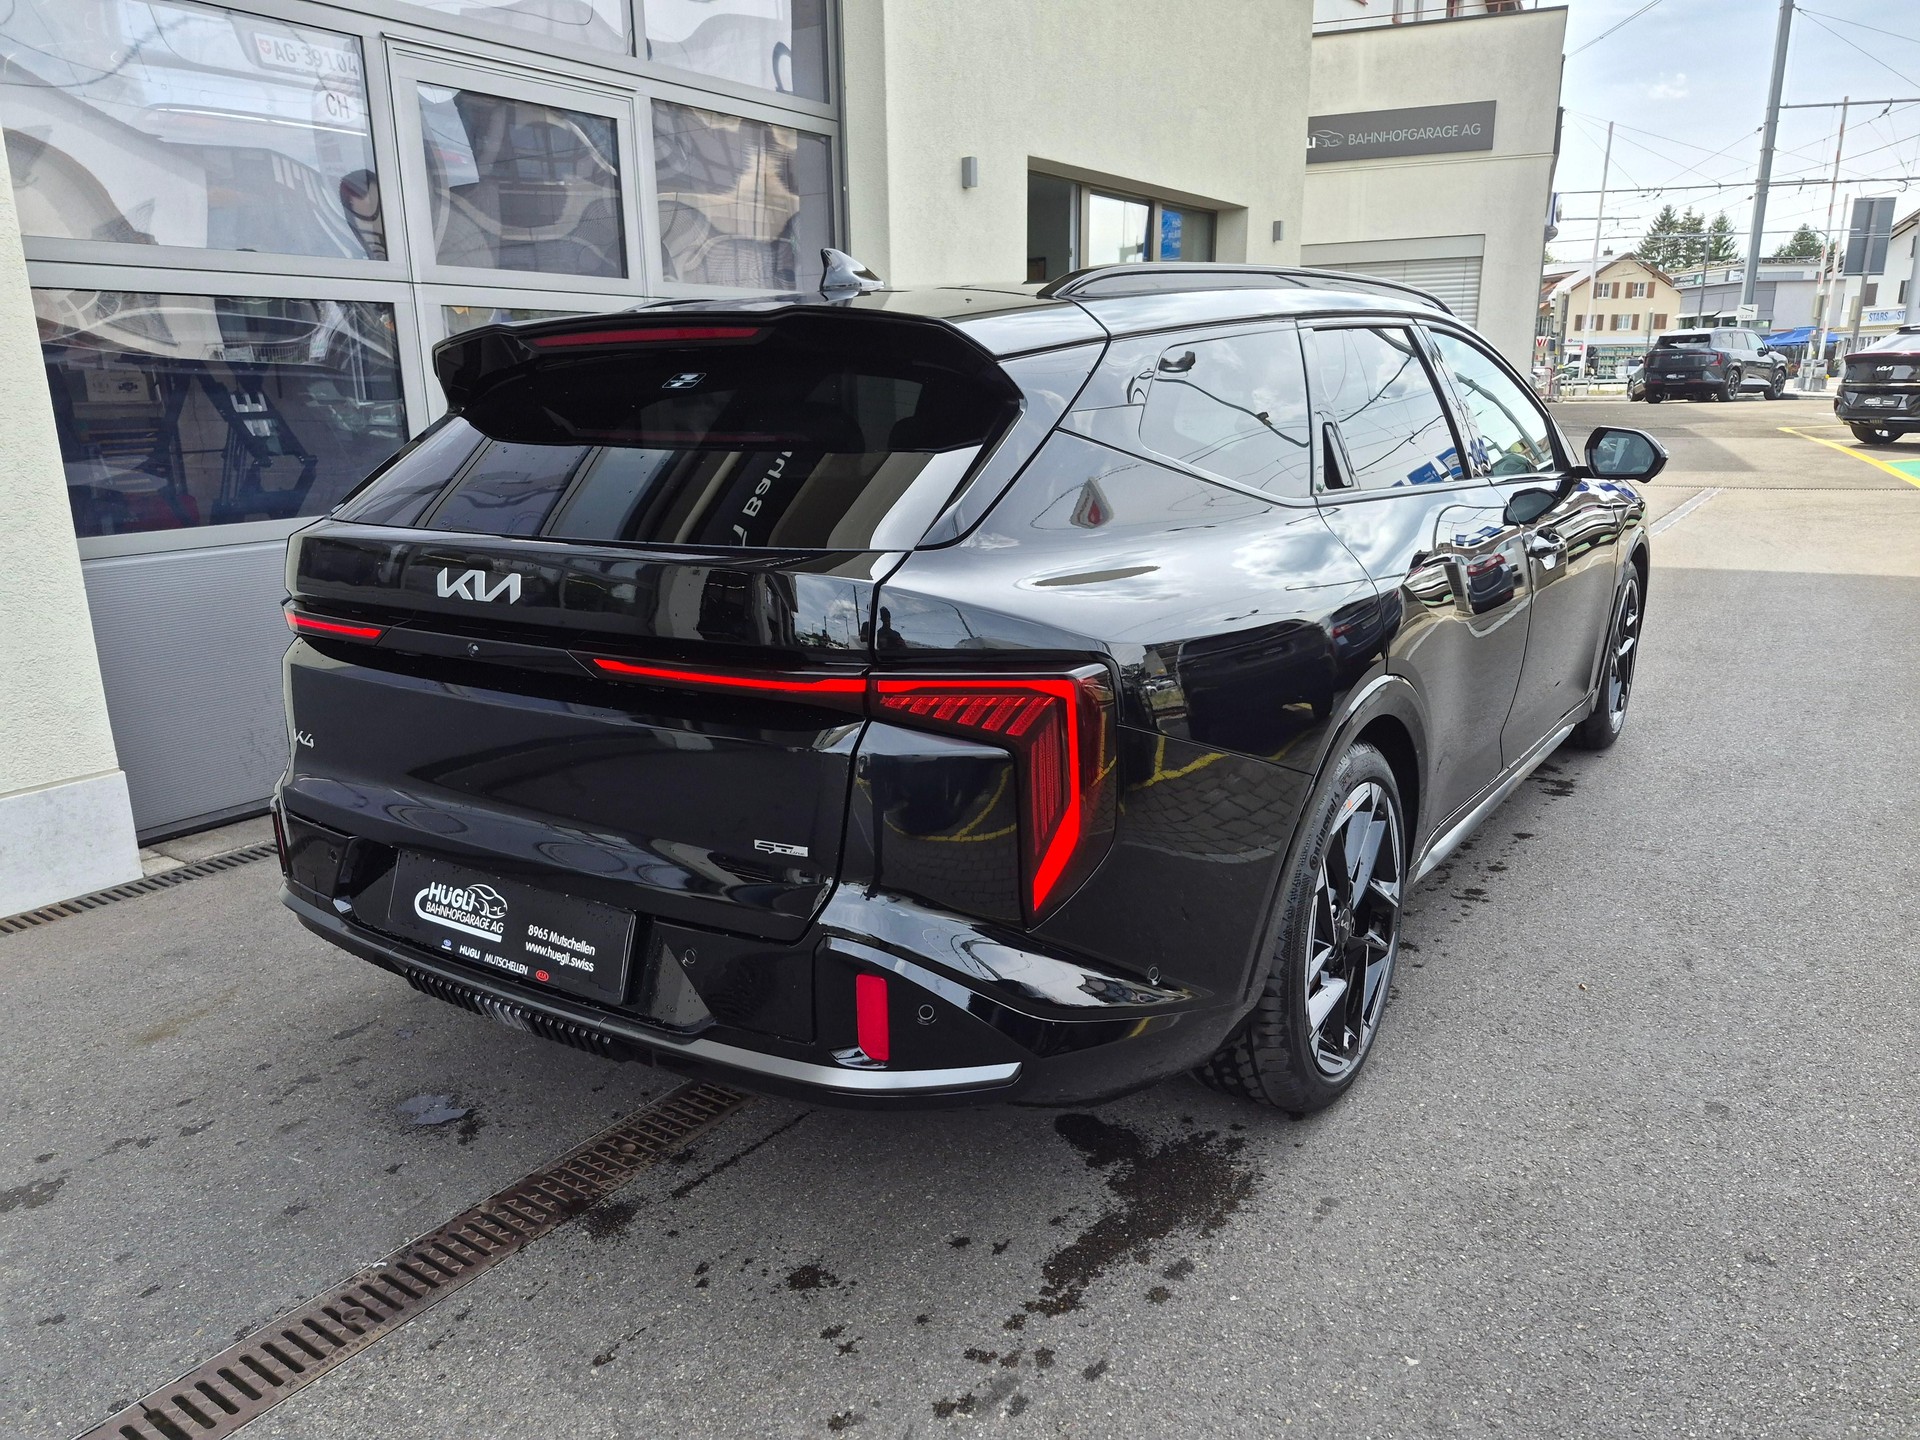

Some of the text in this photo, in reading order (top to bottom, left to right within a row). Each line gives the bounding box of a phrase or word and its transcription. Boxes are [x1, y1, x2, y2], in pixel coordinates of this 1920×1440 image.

[325, 92, 350, 119] CH
[1348, 124, 1459, 146] BAHNHOFGARAGE
[1462, 122, 1482, 136] AG
[1868, 311, 1889, 322] STARS
[436, 567, 522, 605] KIA
[293, 727, 315, 749] K4
[428, 881, 476, 912] HÜGLI
[425, 901, 504, 934] BAHNHOFGARAGE AG
[528, 924, 596, 956] 8965 Mutschellen
[484, 952, 529, 976] MUTSCHELLEN
[525, 941, 594, 972] www.huegli.swiss
